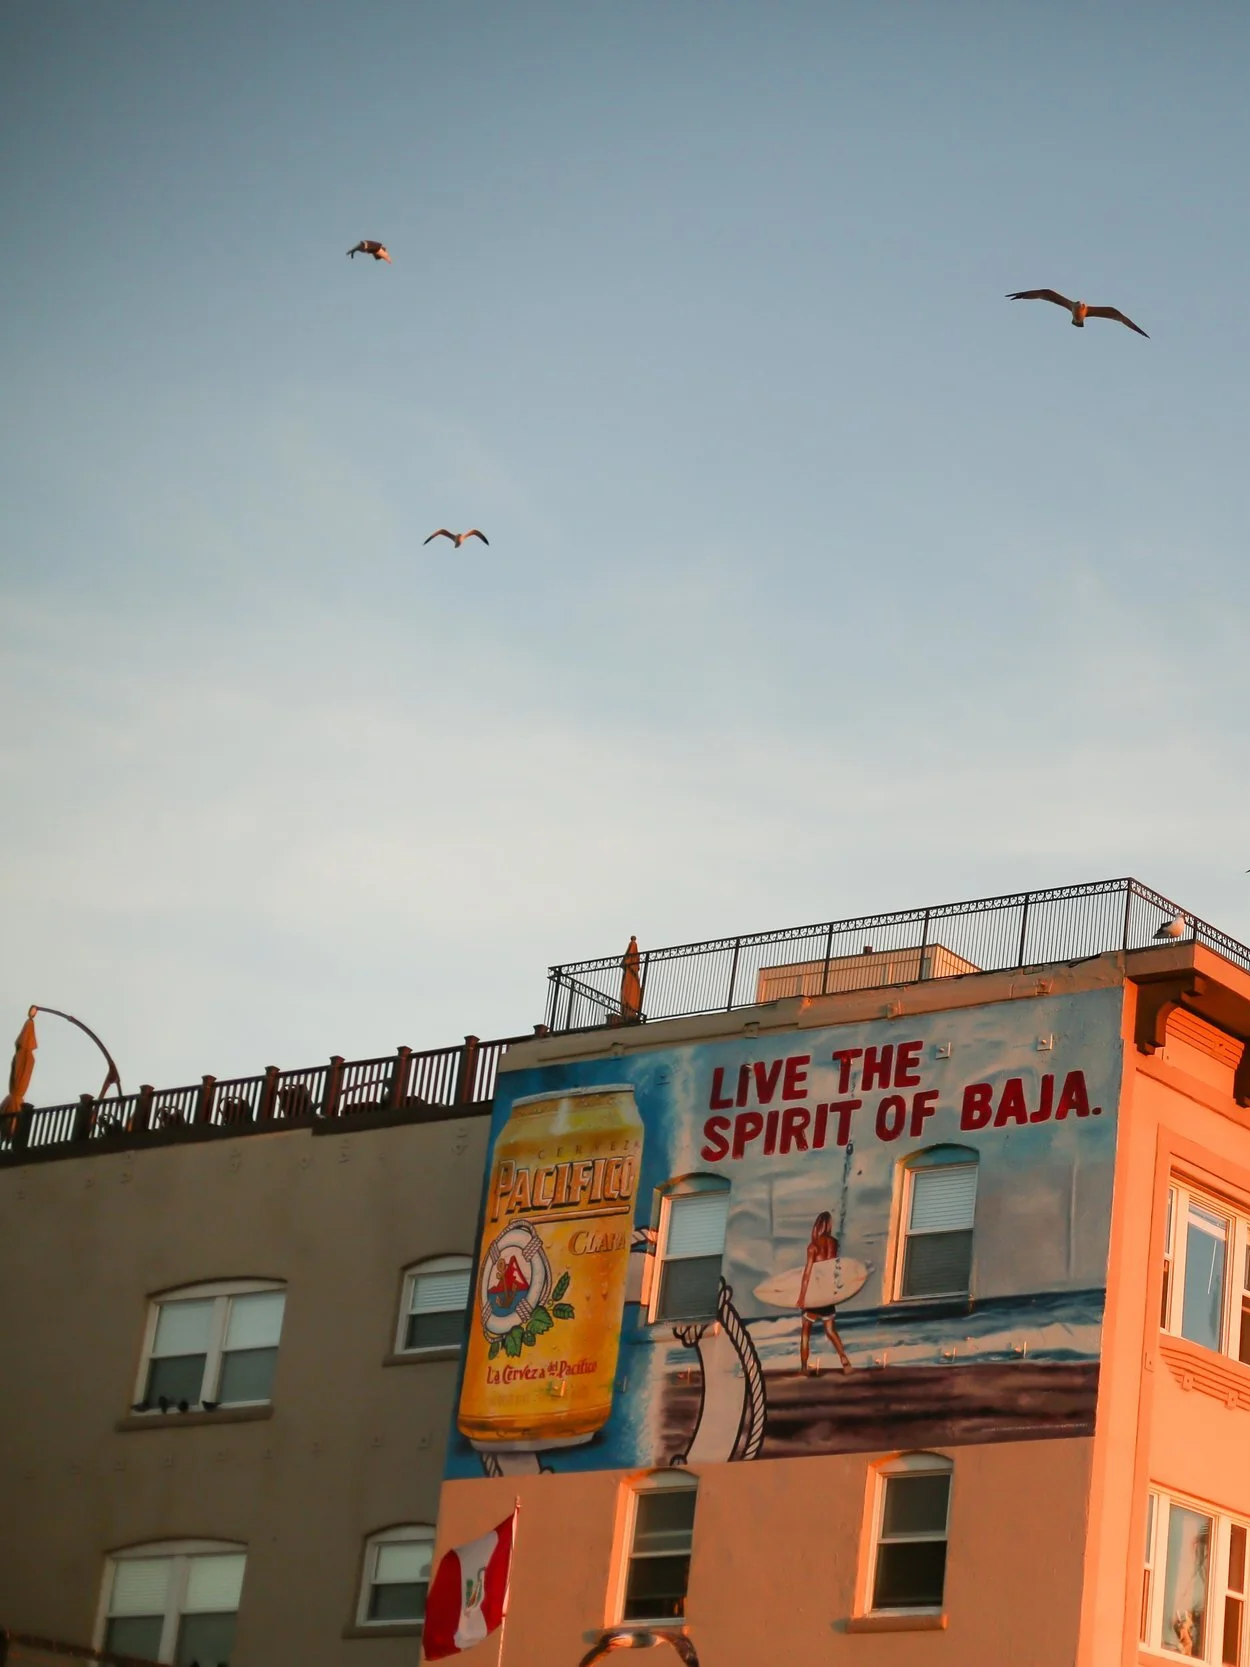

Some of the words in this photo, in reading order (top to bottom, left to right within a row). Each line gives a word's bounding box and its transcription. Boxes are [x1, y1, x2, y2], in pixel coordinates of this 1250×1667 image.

[708, 1055, 811, 1110] LIVE
[832, 1040, 924, 1095] THE
[700, 1099, 863, 1162] SPIRIT
[875, 1089, 940, 1142] OF
[959, 1070, 1103, 1131] BAJA.
[490, 1156, 635, 1222] PACIFICO
[486, 1366, 501, 1385] La
